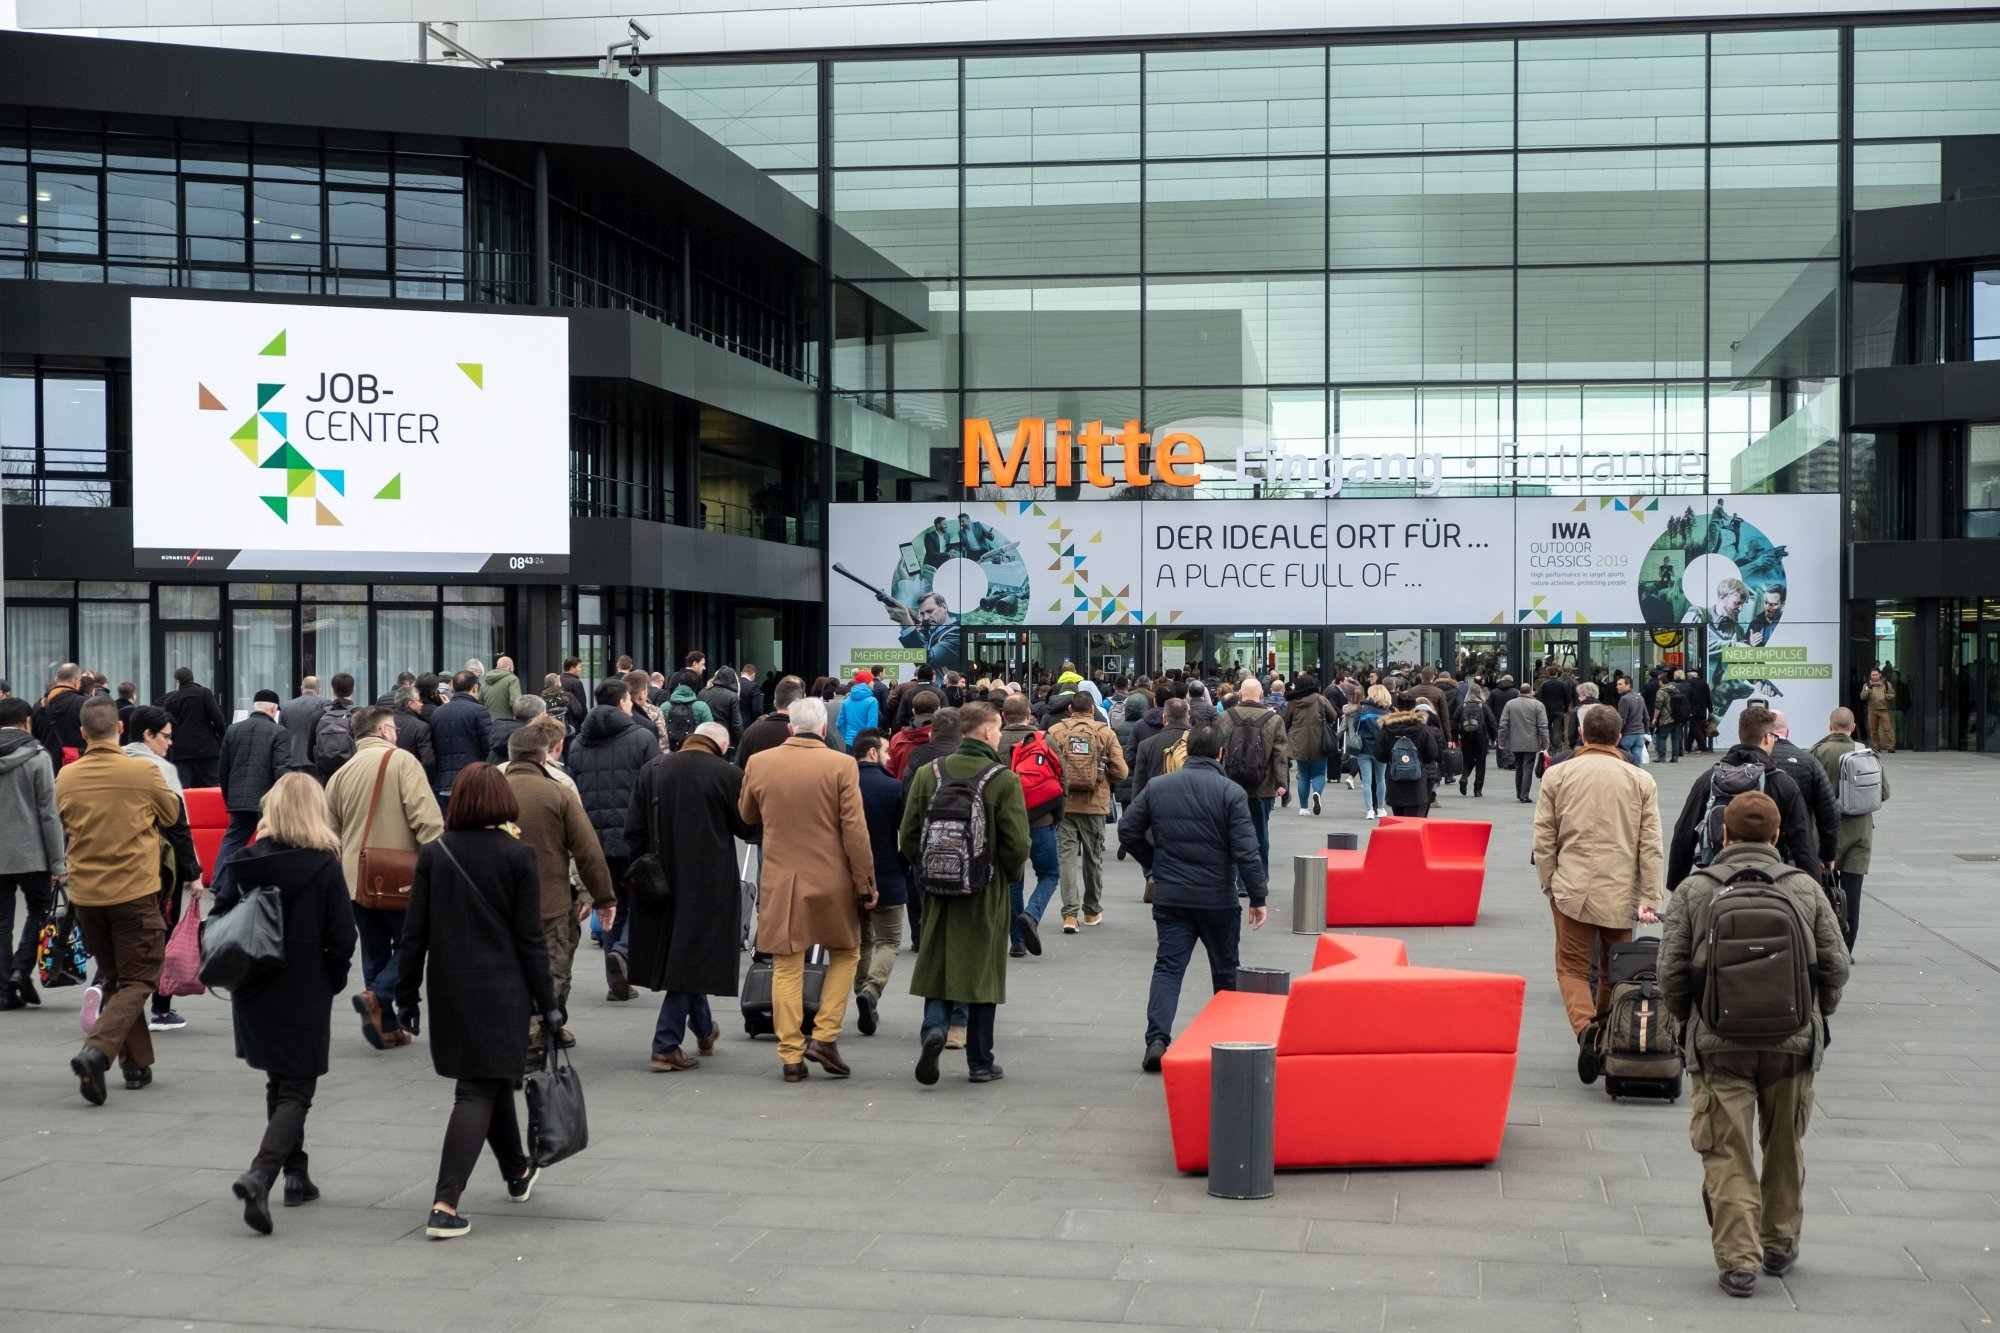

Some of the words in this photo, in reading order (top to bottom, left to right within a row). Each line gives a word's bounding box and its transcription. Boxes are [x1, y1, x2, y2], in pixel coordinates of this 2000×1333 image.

[306, 372, 394, 404] JOB-
[305, 410, 439, 444] CENTER
[964, 418, 1205, 487] Mitte
[1236, 444, 1443, 497] Eingang
[1501, 442, 1702, 482] Entrance
[1156, 525, 1213, 549] DER
[1222, 524, 1328, 549] IDEALE
[1336, 524, 1396, 549] ORT
[1552, 522, 1591, 539] IWA
[1530, 542, 1592, 553] OUTDOOR
[1530, 555, 1592, 568] CLASSICS
[1596, 554, 1628, 567] 2019
[1156, 564, 1176, 588] A
[1186, 564, 1275, 588] PLACE
[1285, 563, 1354, 588] FULL
[854, 650, 883, 660] MEHR
[885, 650, 924, 660] ERFOLG
[1725, 649, 1755, 660] NEUE
[1756, 649, 1804, 660] IMPULSE
[1730, 666, 1767, 677] GREAT
[1769, 666, 1830, 677] AMBITIONS
